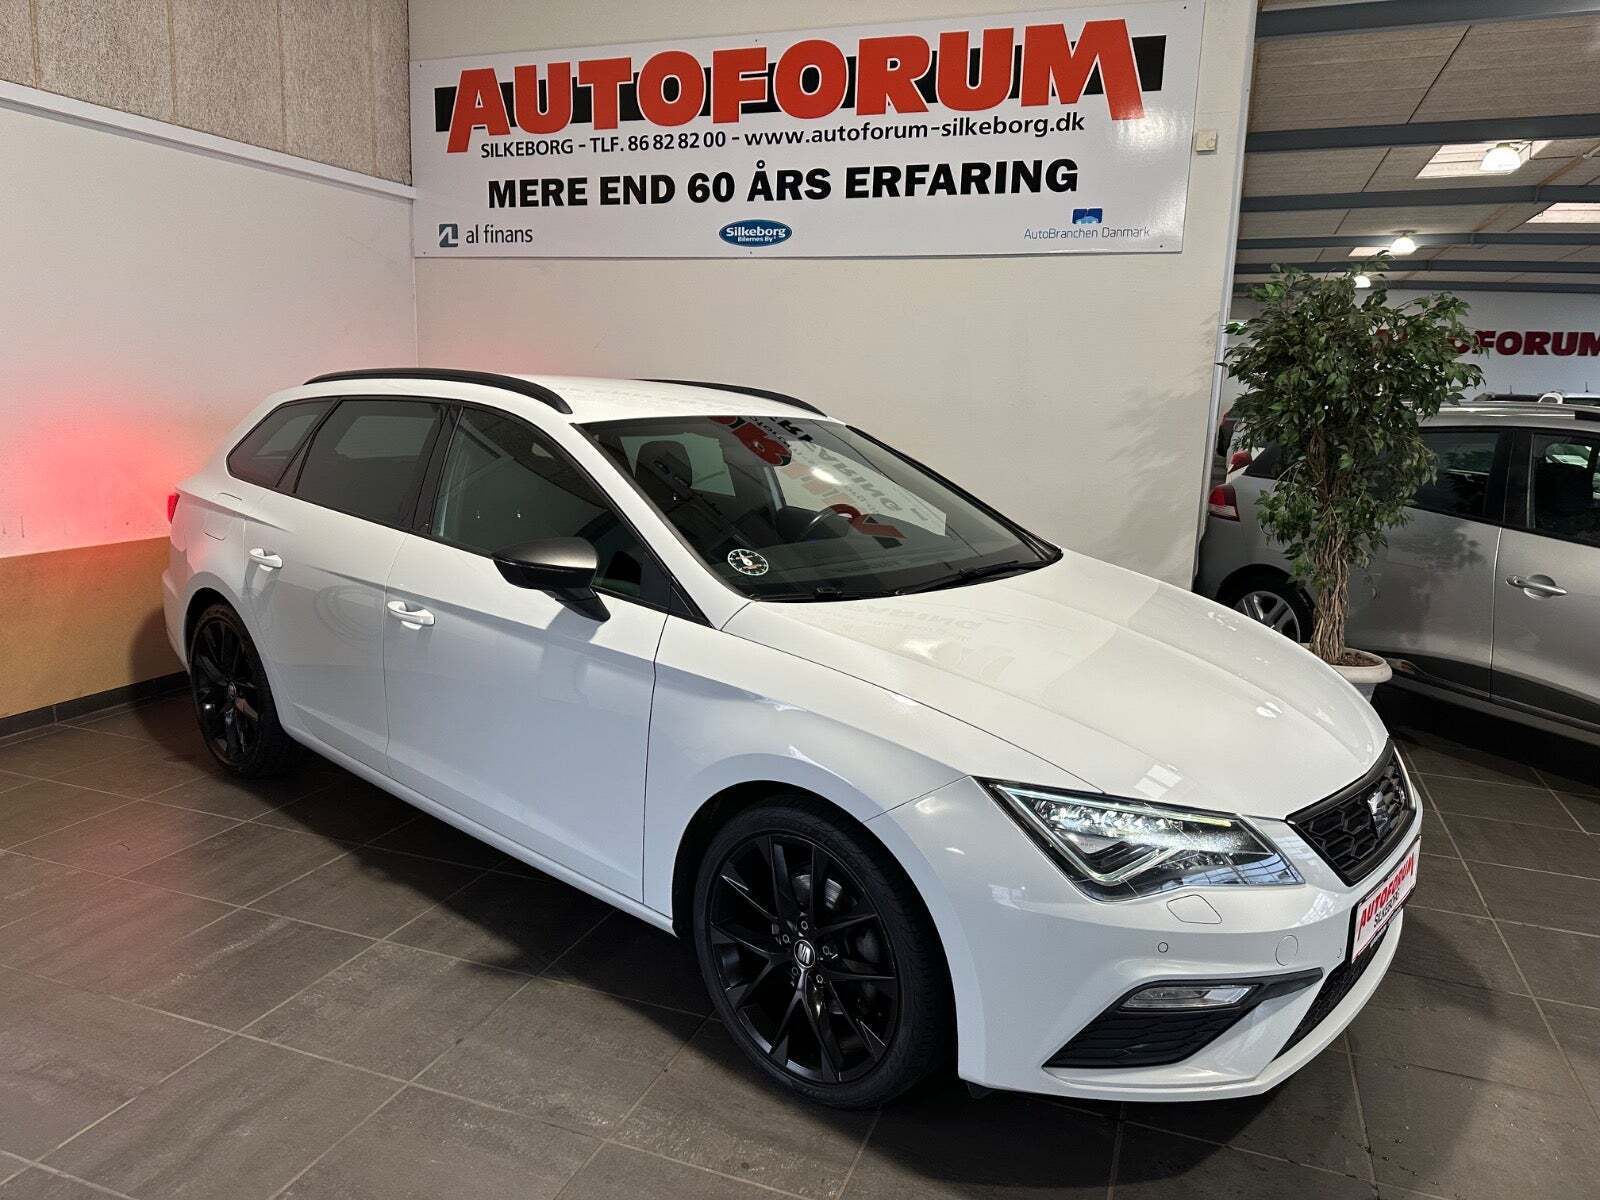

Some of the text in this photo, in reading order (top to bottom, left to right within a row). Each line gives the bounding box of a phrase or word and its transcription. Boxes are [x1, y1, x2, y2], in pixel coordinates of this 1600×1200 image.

[447, 19, 1144, 153] AUTOFORUM
[480, 138, 574, 159] SILKEBORG
[589, 136, 624, 153] TLF.
[744, 111, 1085, 146] www.autoforum-silkeborg.dk
[488, 158, 1079, 209] MERE END 60 ÅRS ERFARING
[465, 223, 534, 244] al finans
[725, 226, 787, 238] Silkeborg
[1023, 225, 1150, 240] AutoBranchen Danmark
[1357, 853, 1414, 941] AUTOFORUM
